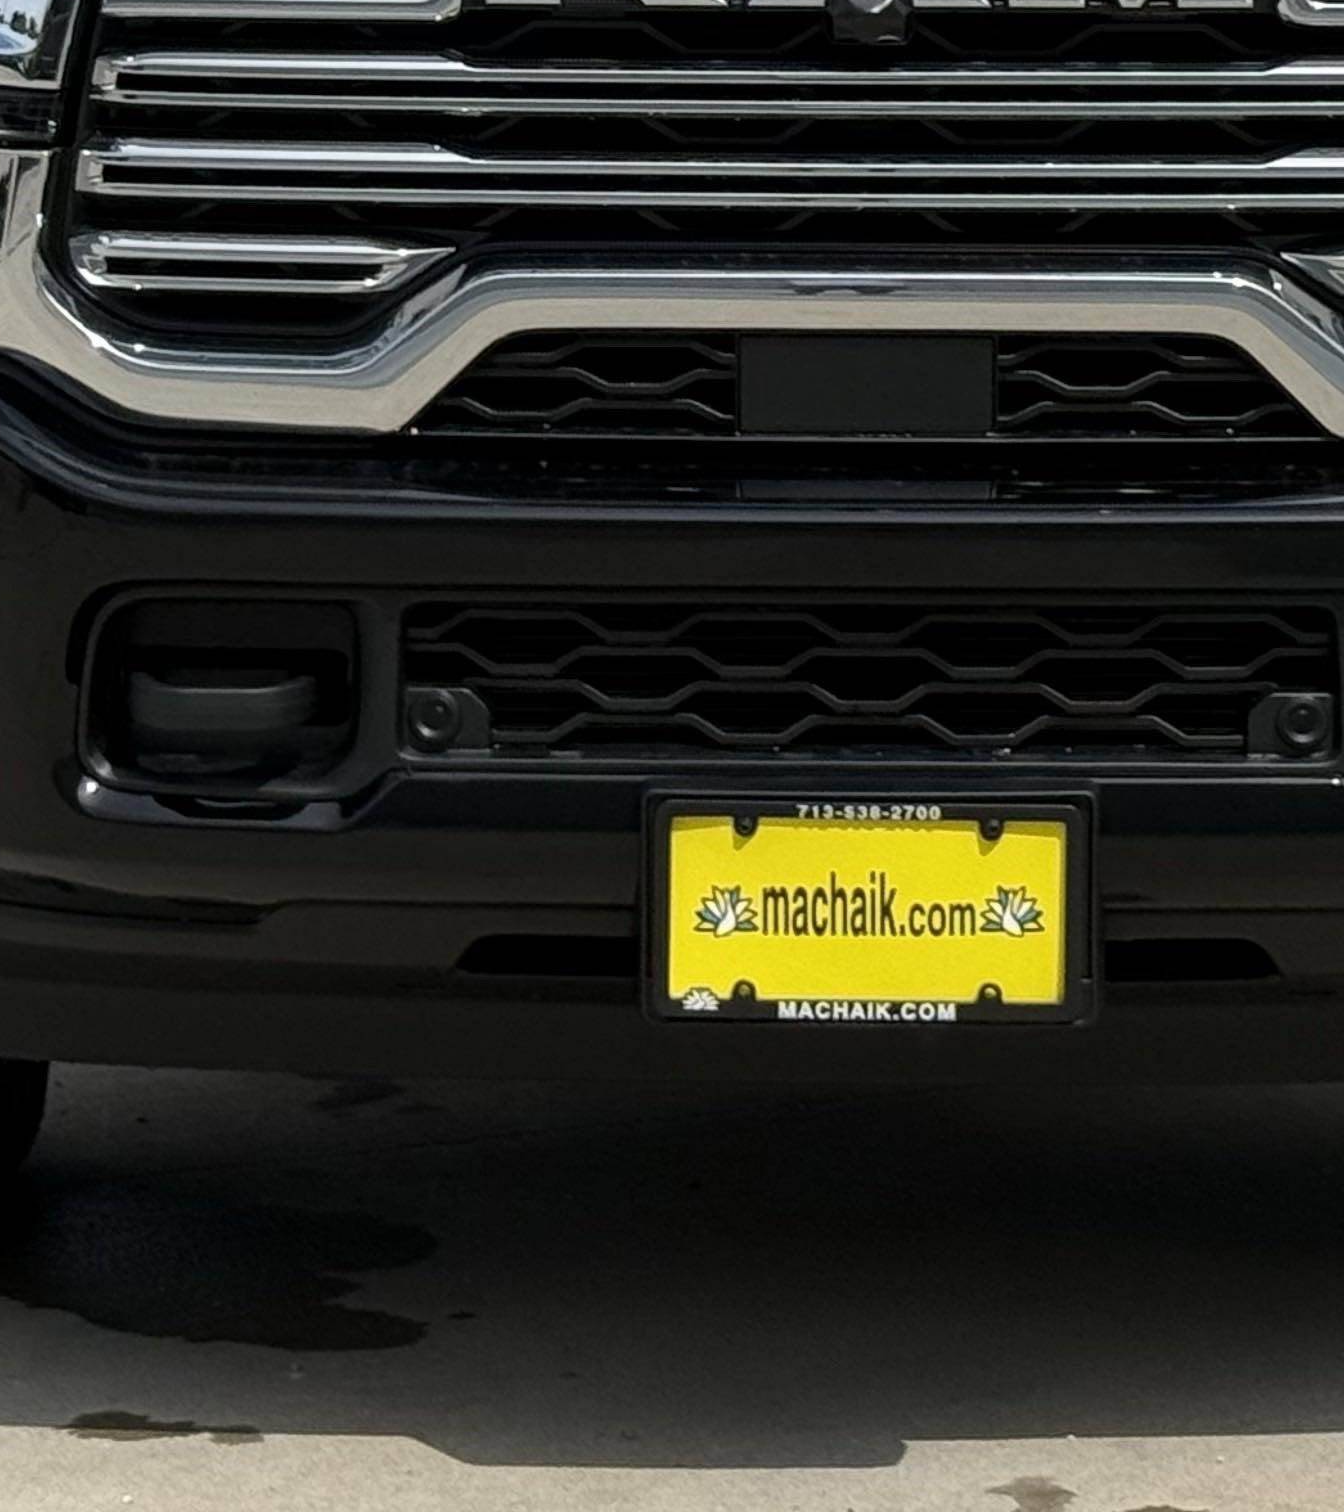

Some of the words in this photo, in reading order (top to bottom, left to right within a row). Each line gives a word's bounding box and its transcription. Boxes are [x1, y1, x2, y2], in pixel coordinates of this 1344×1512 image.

[796, 804, 942, 821] 713-538-2700
[761, 870, 976, 937] machaik.com
[777, 1001, 957, 1022] MACHAIK.COM
